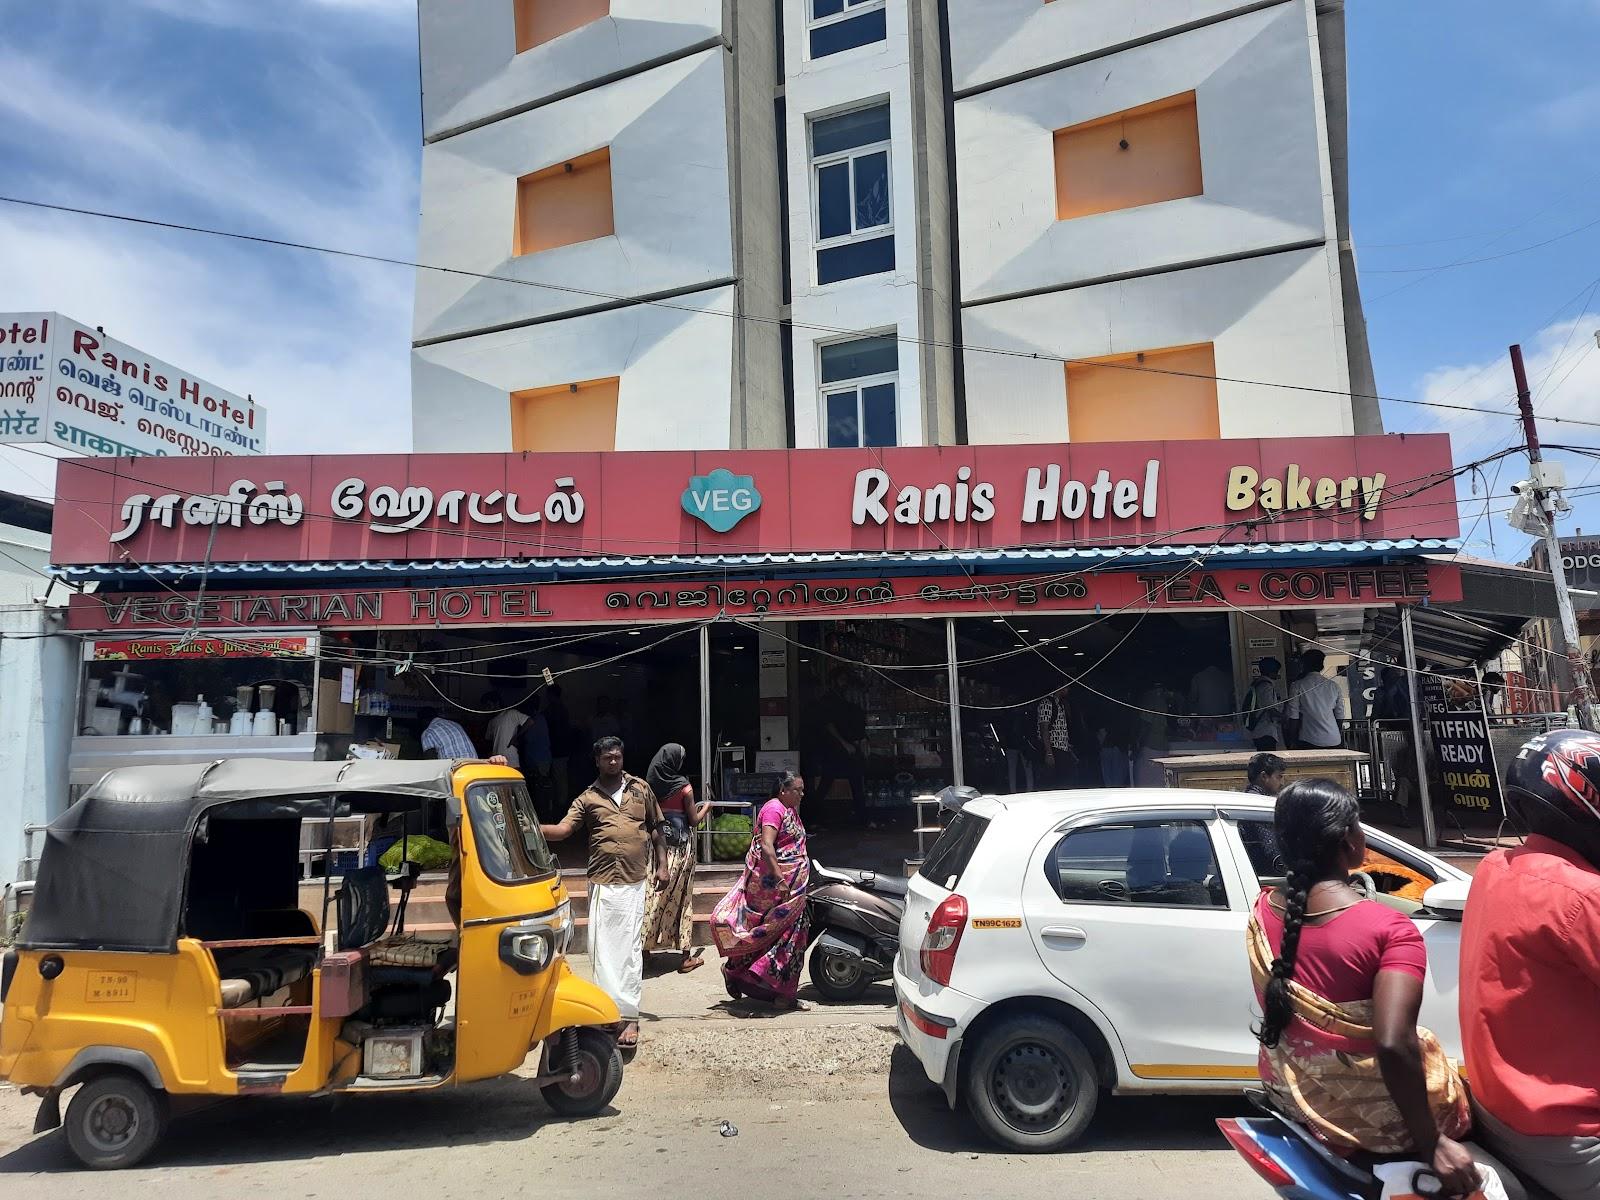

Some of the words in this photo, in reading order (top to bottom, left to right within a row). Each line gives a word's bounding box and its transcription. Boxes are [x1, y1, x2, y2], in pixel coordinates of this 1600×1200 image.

[0, 319, 48, 344] otel
[58, 358, 121, 397] வெஜ்
[73, 330, 168, 391] Ranis
[180, 379, 254, 430] Hotel
[330, 476, 585, 534] ஹோட்டல்
[691, 488, 752, 512] VEG
[852, 466, 996, 526] Ranis
[1022, 459, 1160, 523] Hotel
[1226, 464, 1387, 521] Bakery
[1561, 554, 1600, 570] ODG
[1136, 574, 1228, 604] TEA
[1258, 567, 1432, 602] COFFEE
[101, 592, 383, 624] VEGETARIAN
[409, 589, 553, 619] HOTEL
[128, 642, 162, 657] Ranis
[205, 642, 215, 654] &
[1432, 720, 1485, 738] TIFFIN
[1440, 744, 1484, 763] READY
[1443, 769, 1491, 790] டிபன்
[974, 920, 1022, 928] TN99C1623
